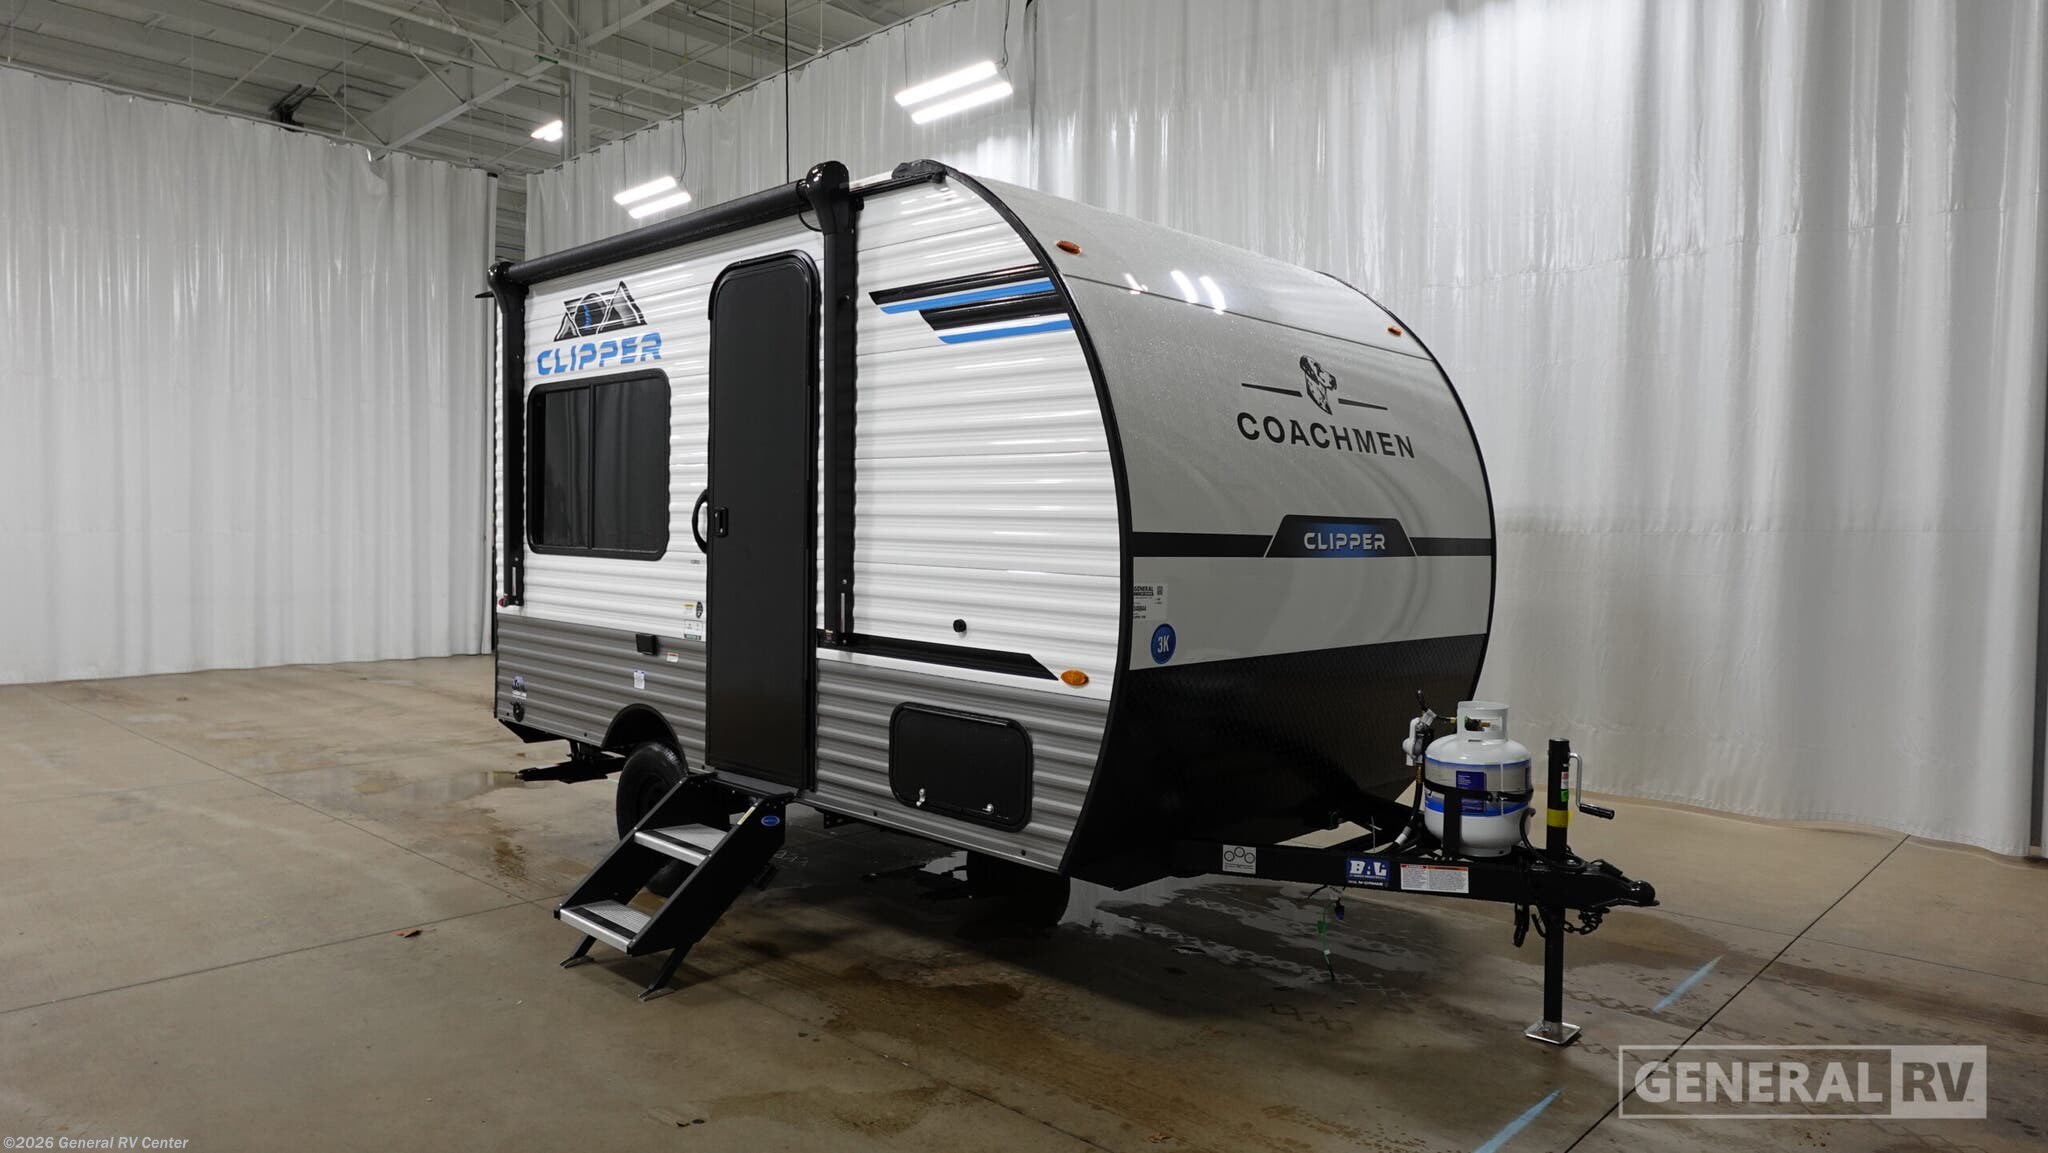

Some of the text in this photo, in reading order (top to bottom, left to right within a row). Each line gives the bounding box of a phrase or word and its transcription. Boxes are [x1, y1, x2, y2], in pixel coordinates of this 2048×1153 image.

[537, 332, 662, 375] CLIPPER
[1237, 412, 1415, 458] COACHMEN
[1304, 532, 1386, 550] CLIPPER
[1157, 635, 1170, 653] 3K
[1350, 860, 1387, 876] BAL
